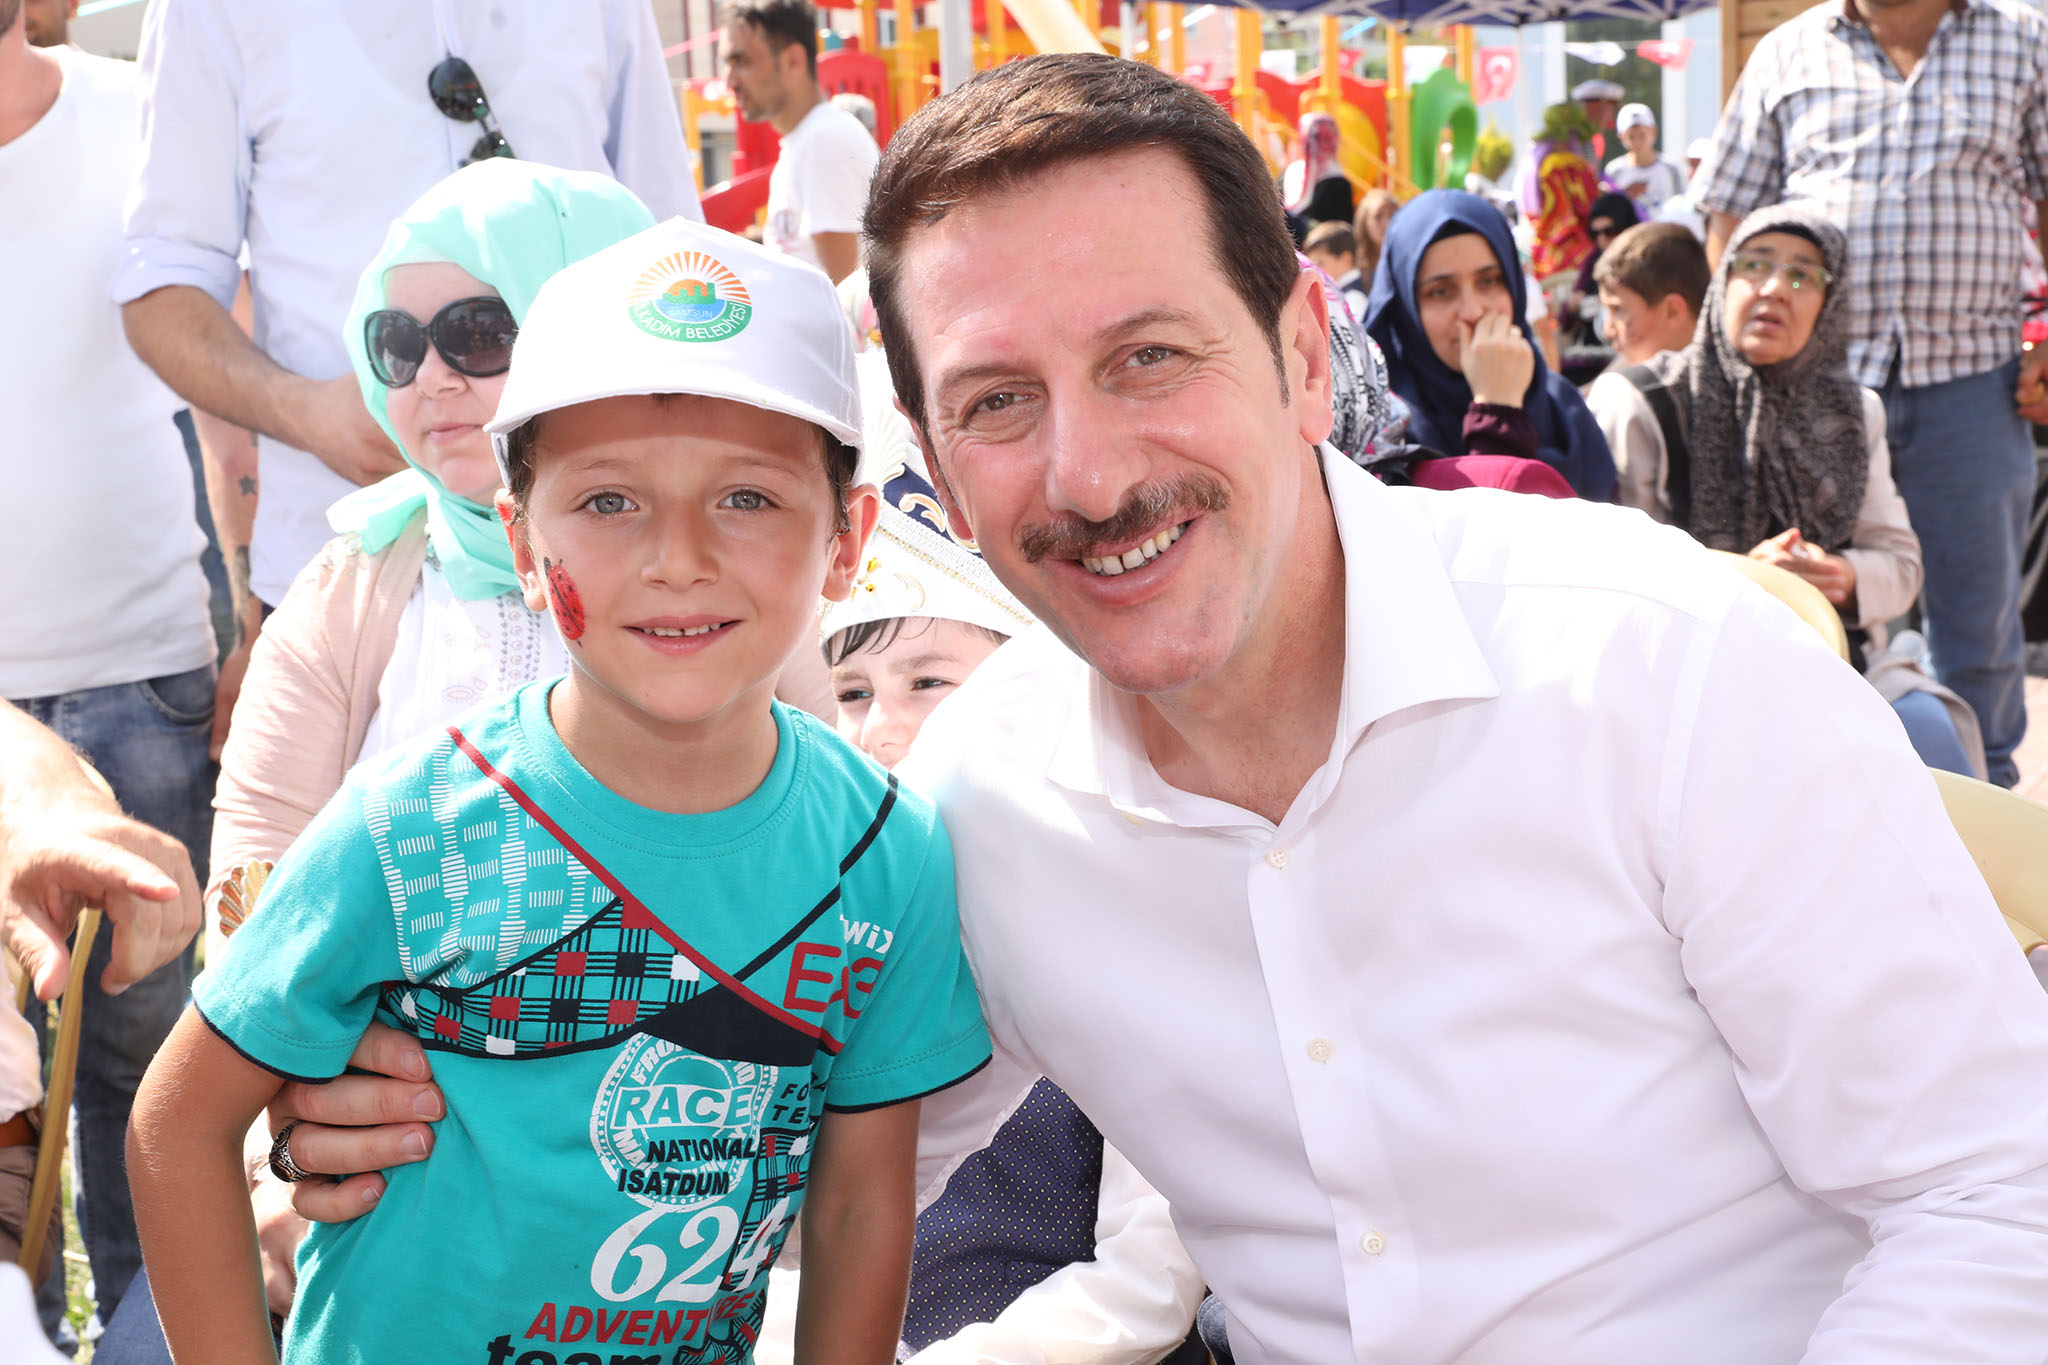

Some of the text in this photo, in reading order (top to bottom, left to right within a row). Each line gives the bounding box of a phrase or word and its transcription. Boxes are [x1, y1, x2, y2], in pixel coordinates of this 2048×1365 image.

[613, 1086, 754, 1128] RACE
[646, 1138, 758, 1163] NATIONAL
[617, 1168, 731, 1196] ISATDUM
[590, 1196, 790, 1304] 624
